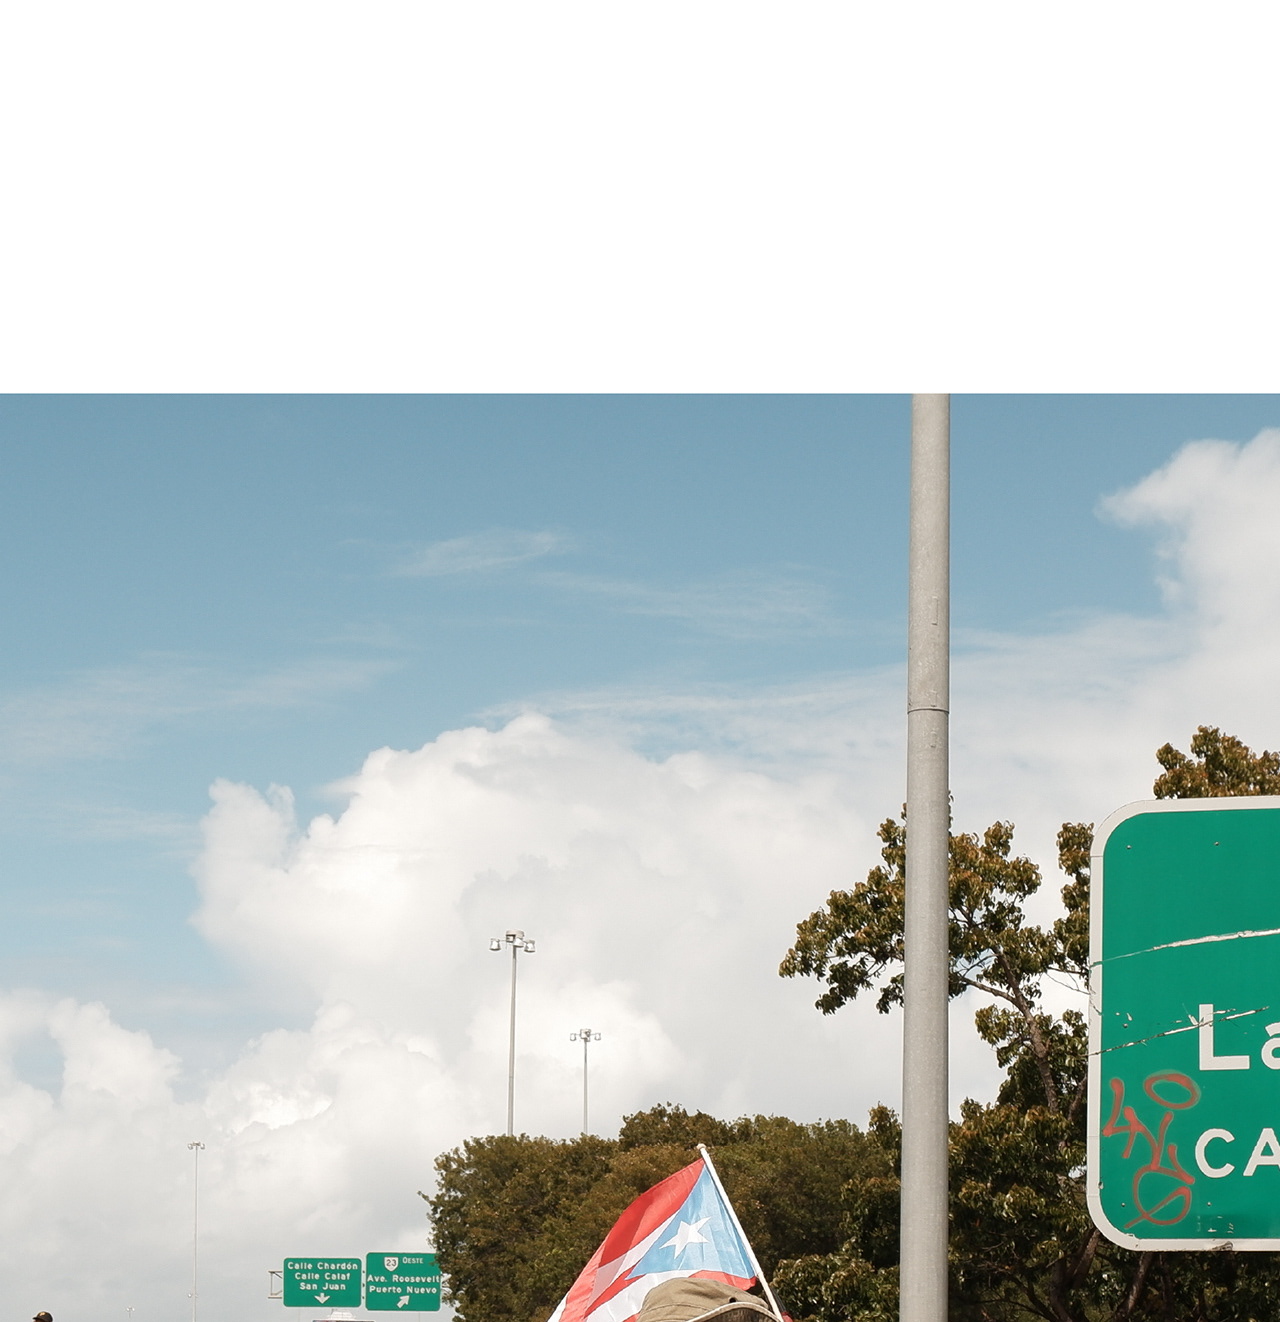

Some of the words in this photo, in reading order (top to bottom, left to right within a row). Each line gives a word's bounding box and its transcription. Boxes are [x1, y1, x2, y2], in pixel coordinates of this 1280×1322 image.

[402, 1256, 424, 1264] OESTE
[287, 1261, 313, 1270] Calle
[317, 1261, 358, 1270] Chardón
[294, 1272, 320, 1280] Calle
[324, 1272, 351, 1280] Calaf
[367, 1274, 388, 1282] Ave.
[392, 1274, 440, 1283] Roosevelt
[299, 1282, 318, 1290] San
[322, 1282, 346, 1290] Juan
[369, 1285, 402, 1294] Puerto
[406, 1286, 437, 1294] Nuevo
